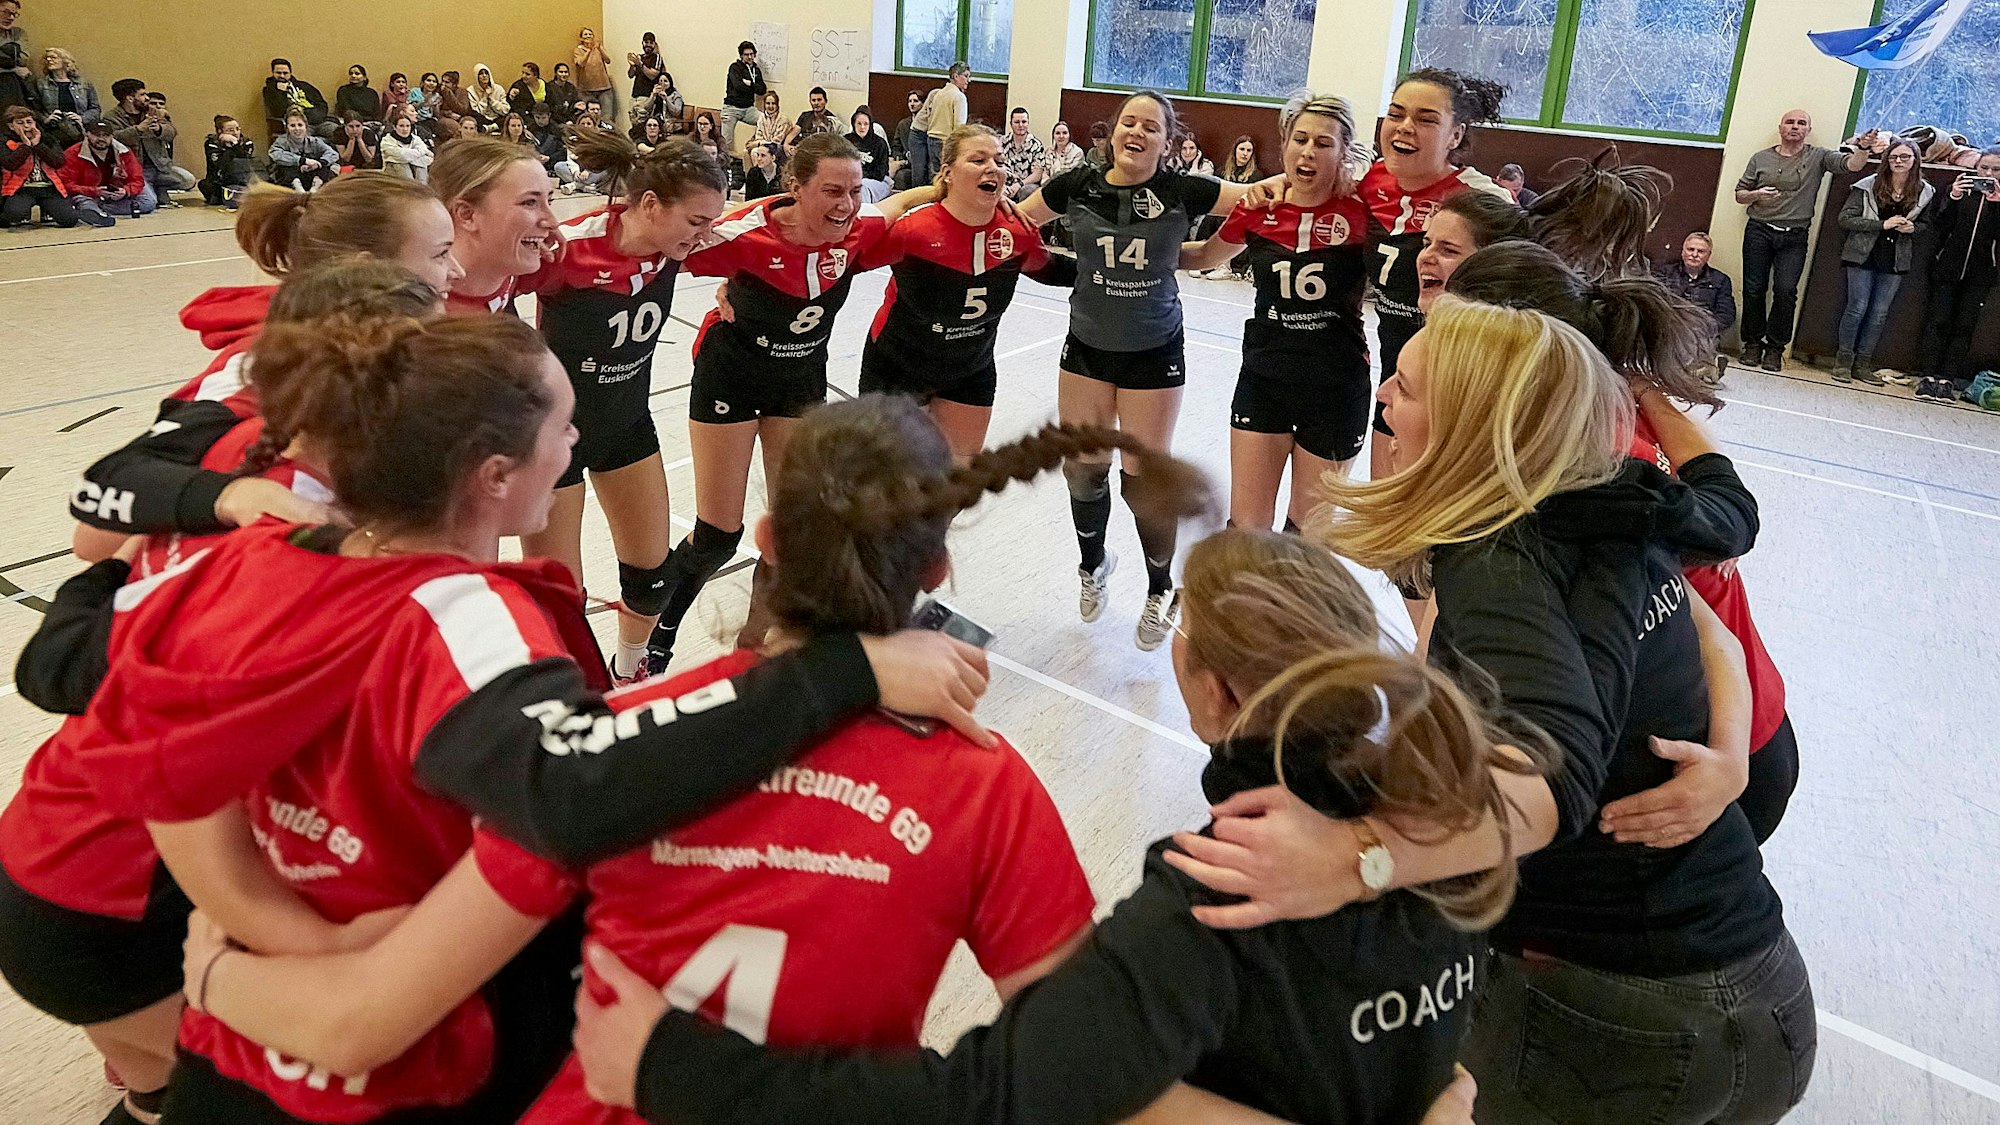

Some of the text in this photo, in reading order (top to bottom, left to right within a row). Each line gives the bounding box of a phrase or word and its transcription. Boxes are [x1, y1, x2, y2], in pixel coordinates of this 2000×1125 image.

[1096, 235, 1149, 271] 14
[1377, 242, 1400, 286] 7
[1105, 287, 1148, 298] Euskirchen
[1271, 260, 1327, 301] 16
[789, 305, 825, 335] 8
[960, 287, 988, 320] 5
[608, 301, 662, 349] 10
[1637, 574, 1685, 641] OACH
[327, 825, 365, 865] 69
[889, 806, 933, 855] 69
[1351, 954, 1475, 1044] COACH
